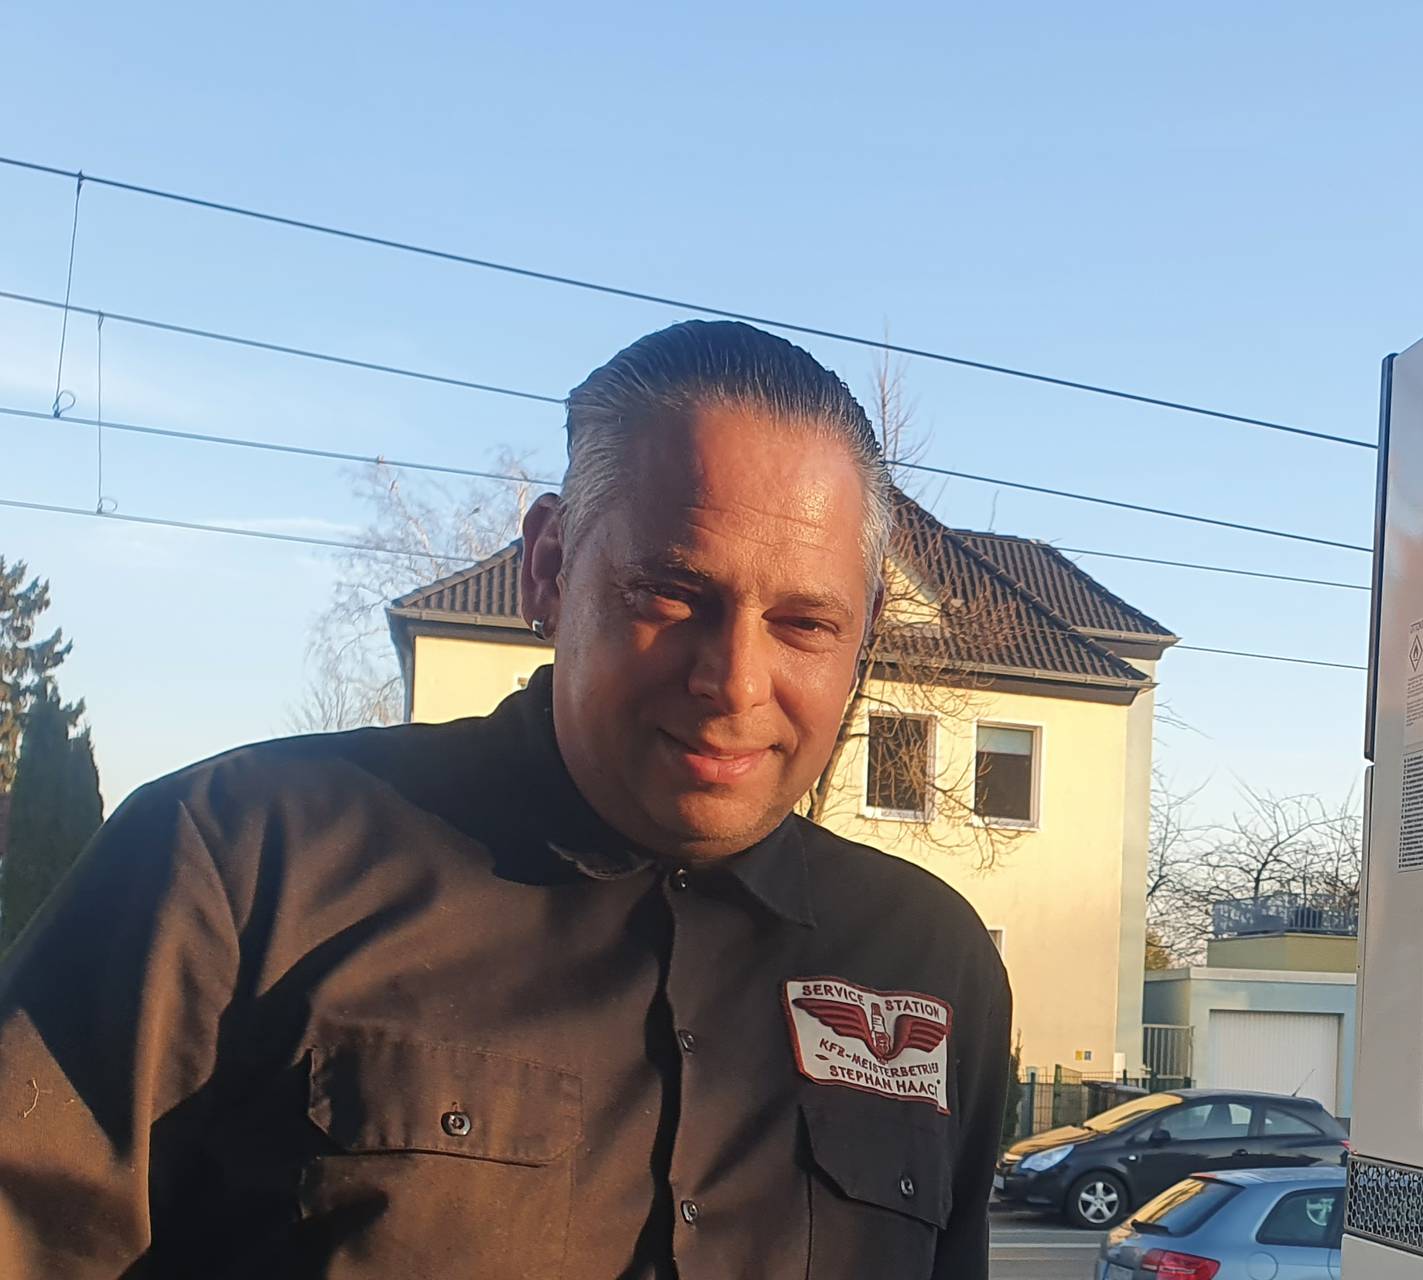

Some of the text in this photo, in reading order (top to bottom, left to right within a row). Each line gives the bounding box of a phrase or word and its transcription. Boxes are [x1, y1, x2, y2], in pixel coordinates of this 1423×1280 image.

[802, 984, 940, 1020] SERVICE STATION
[829, 1064, 892, 1092] STEPHAN
